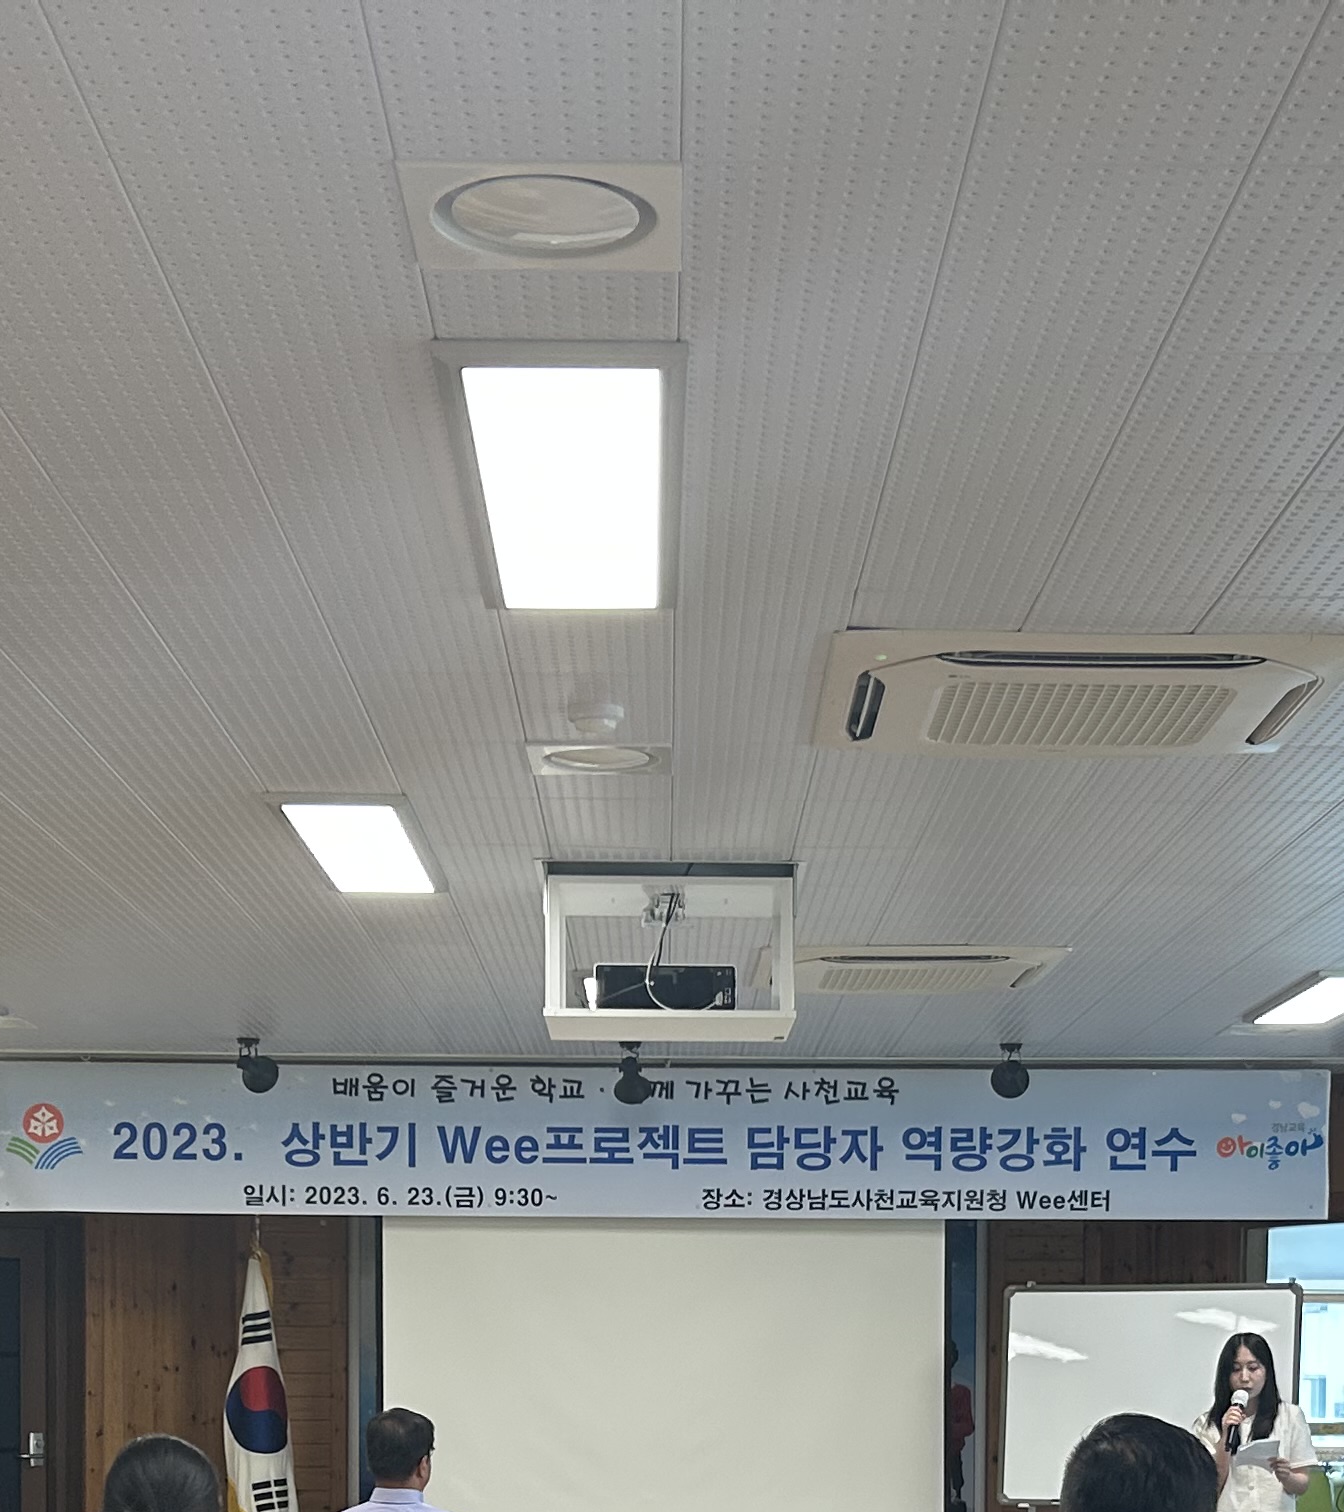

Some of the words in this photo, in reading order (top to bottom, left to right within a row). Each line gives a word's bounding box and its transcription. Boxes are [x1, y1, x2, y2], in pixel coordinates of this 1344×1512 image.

[332, 1072, 416, 1102] 배움이
[431, 1073, 517, 1104] 즐거운
[529, 1074, 585, 1104] 학교
[685, 1077, 772, 1105] 가꾸는
[784, 1076, 900, 1105] 사천교육
[112, 1121, 244, 1162] 2023.
[281, 1121, 417, 1169] 상반기
[437, 1122, 728, 1171] Wee프로젝트
[746, 1124, 884, 1172] 담당자
[902, 1124, 1089, 1173] 역량강화
[1105, 1124, 1197, 1173] 연수
[1216, 1133, 1324, 1171] 아이좋아
[243, 1184, 295, 1207] 일시:
[305, 1186, 368, 1206] 2023.
[377, 1186, 397, 1206] 6.
[407, 1185, 484, 1208] 23.(금)
[494, 1187, 558, 1208] 9:30~
[701, 1188, 753, 1210] 장소:
[762, 1188, 1008, 1212] 경상남도사천교육지원청
[1016, 1189, 1112, 1212] Wee센터
